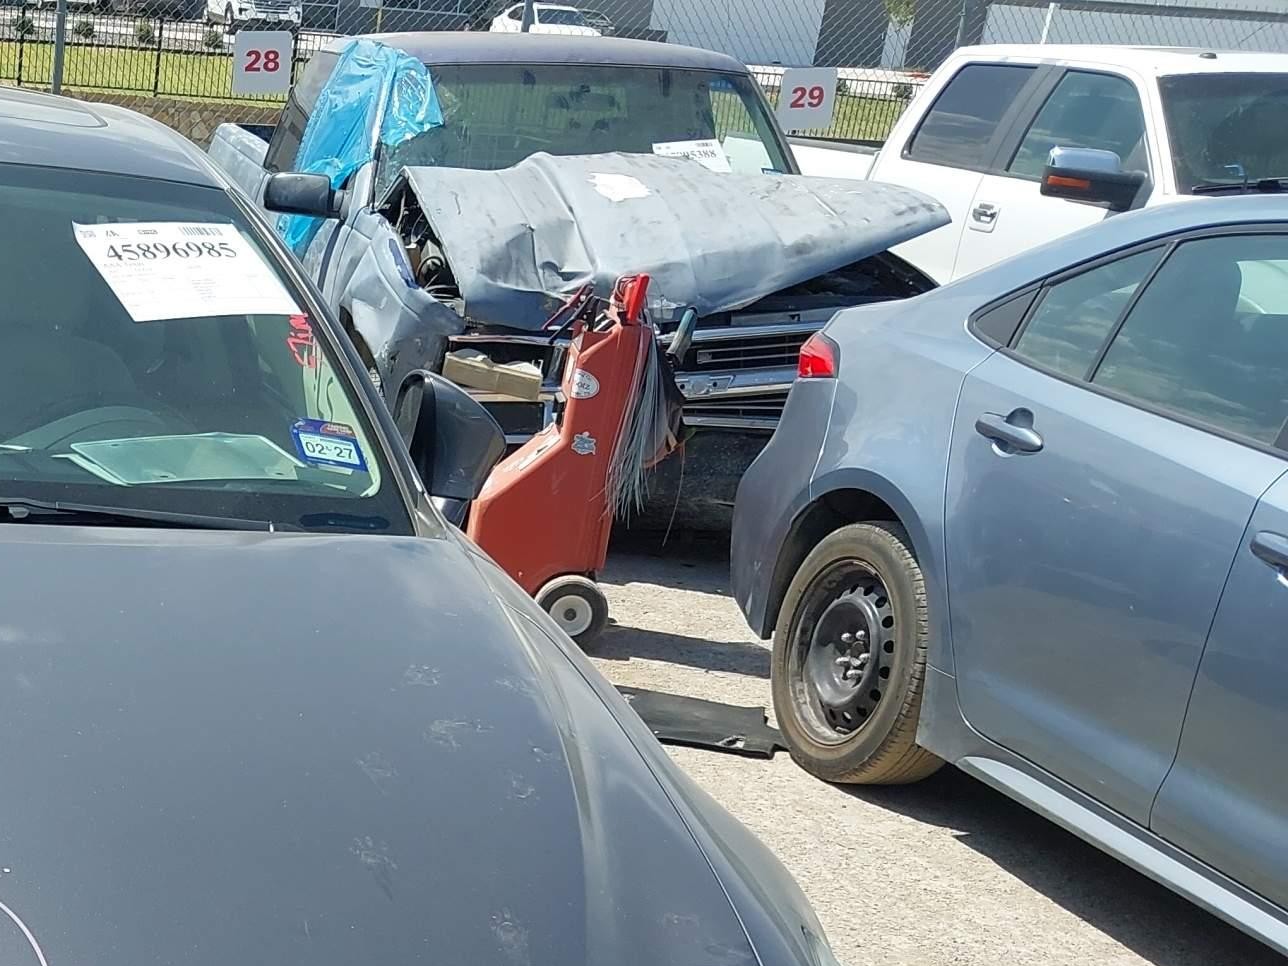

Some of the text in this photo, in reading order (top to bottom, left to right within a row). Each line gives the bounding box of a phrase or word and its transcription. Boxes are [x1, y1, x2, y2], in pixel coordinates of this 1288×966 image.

[244, 49, 280, 73] 28
[789, 85, 825, 109] 29
[106, 240, 238, 261] 45896985
[305, 441, 353, 460] 02 27
